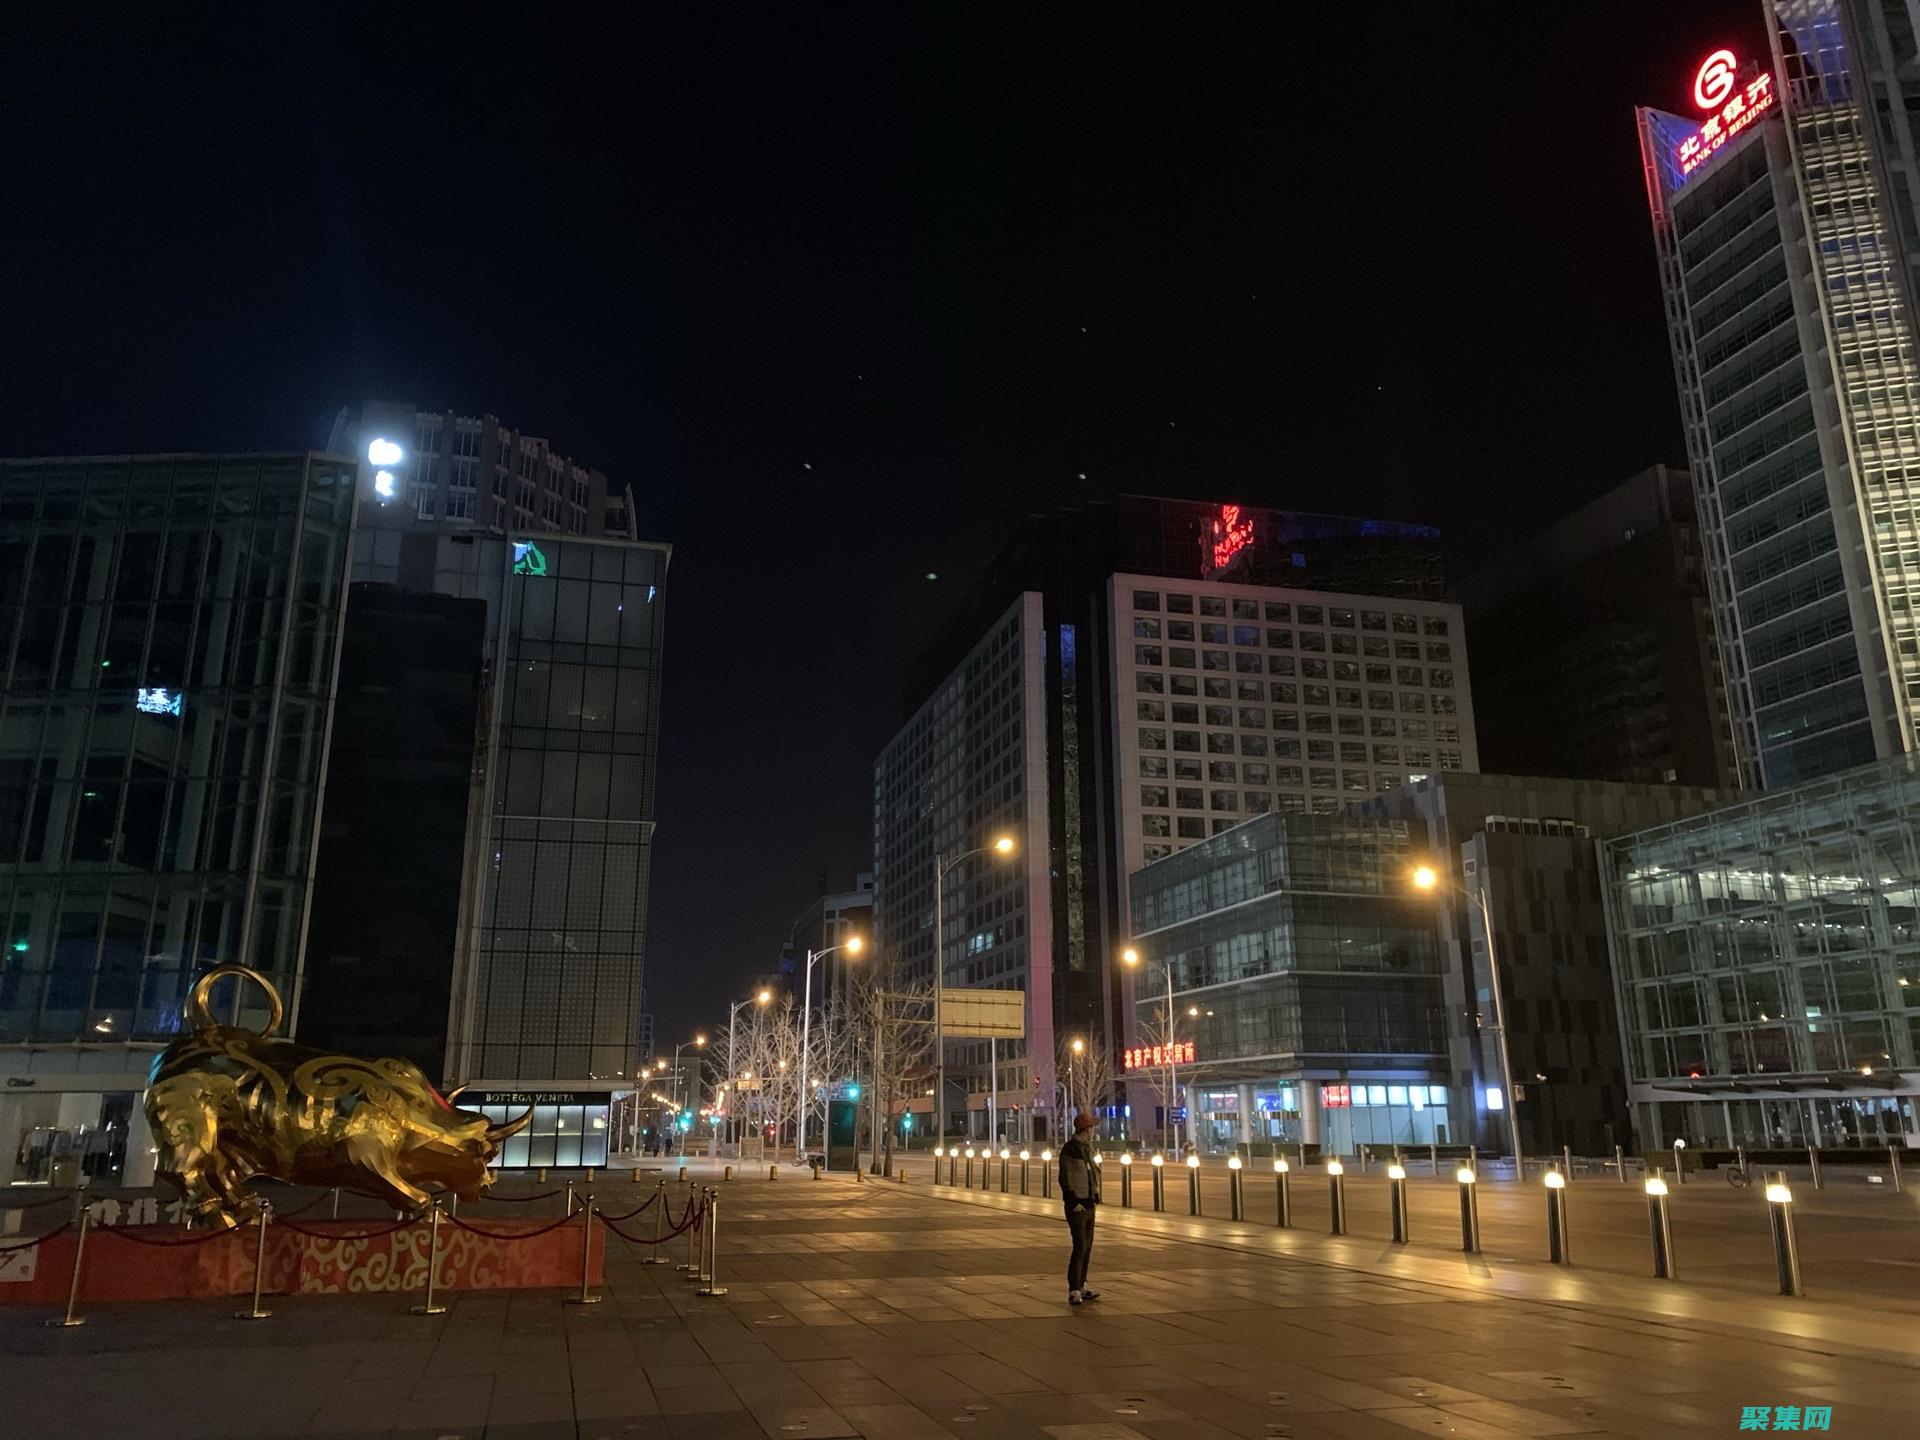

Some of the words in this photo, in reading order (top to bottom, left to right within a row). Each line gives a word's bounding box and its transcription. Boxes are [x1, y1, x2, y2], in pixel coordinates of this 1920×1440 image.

[1680, 73, 1770, 161] 北京银行
[1684, 145, 1712, 174] BANK
[1713, 132, 1726, 149] OF
[1729, 95, 1773, 137] BEIJING
[1125, 1042, 1194, 1068] 北京产权交易所
[485, 1093, 532, 1102] BOTTEGA
[535, 1093, 575, 1102] VENETA
